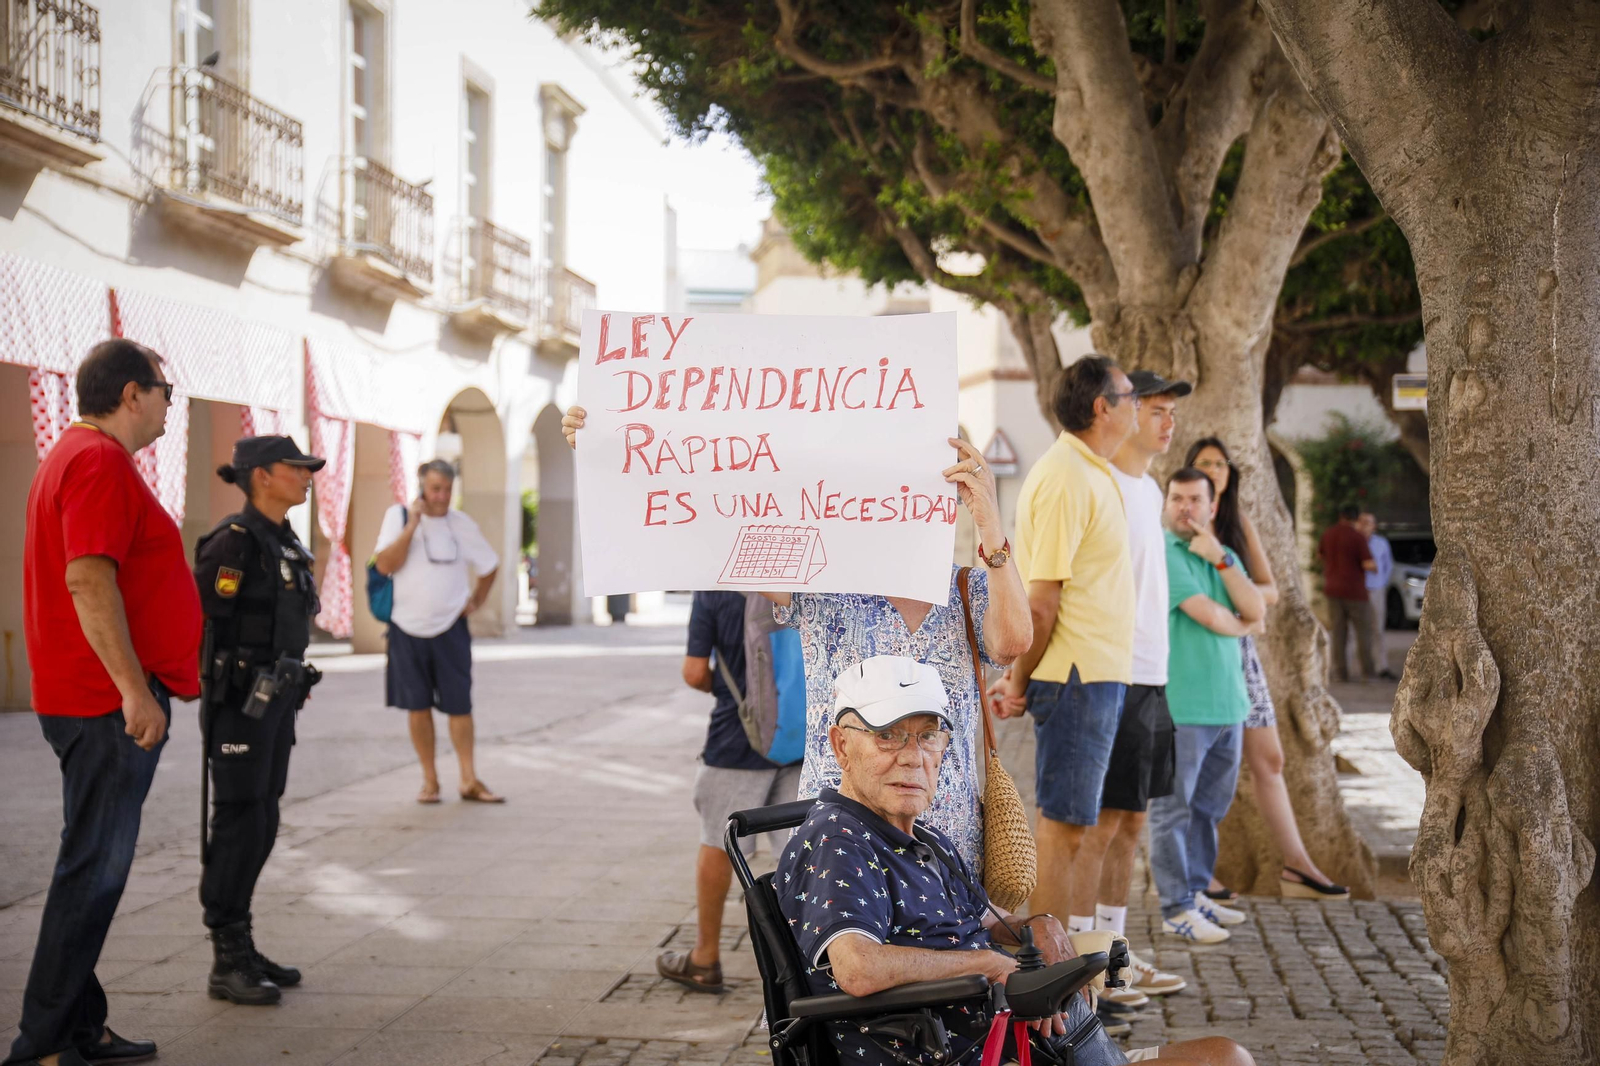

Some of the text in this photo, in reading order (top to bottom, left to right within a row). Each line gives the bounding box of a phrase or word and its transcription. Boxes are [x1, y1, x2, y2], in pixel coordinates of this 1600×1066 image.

[595, 313, 693, 365] LEY
[616, 423, 781, 476] RÁPIDA
[643, 489, 698, 527] ES
[713, 492, 784, 519] UNA
[221, 743, 250, 754] CNP
